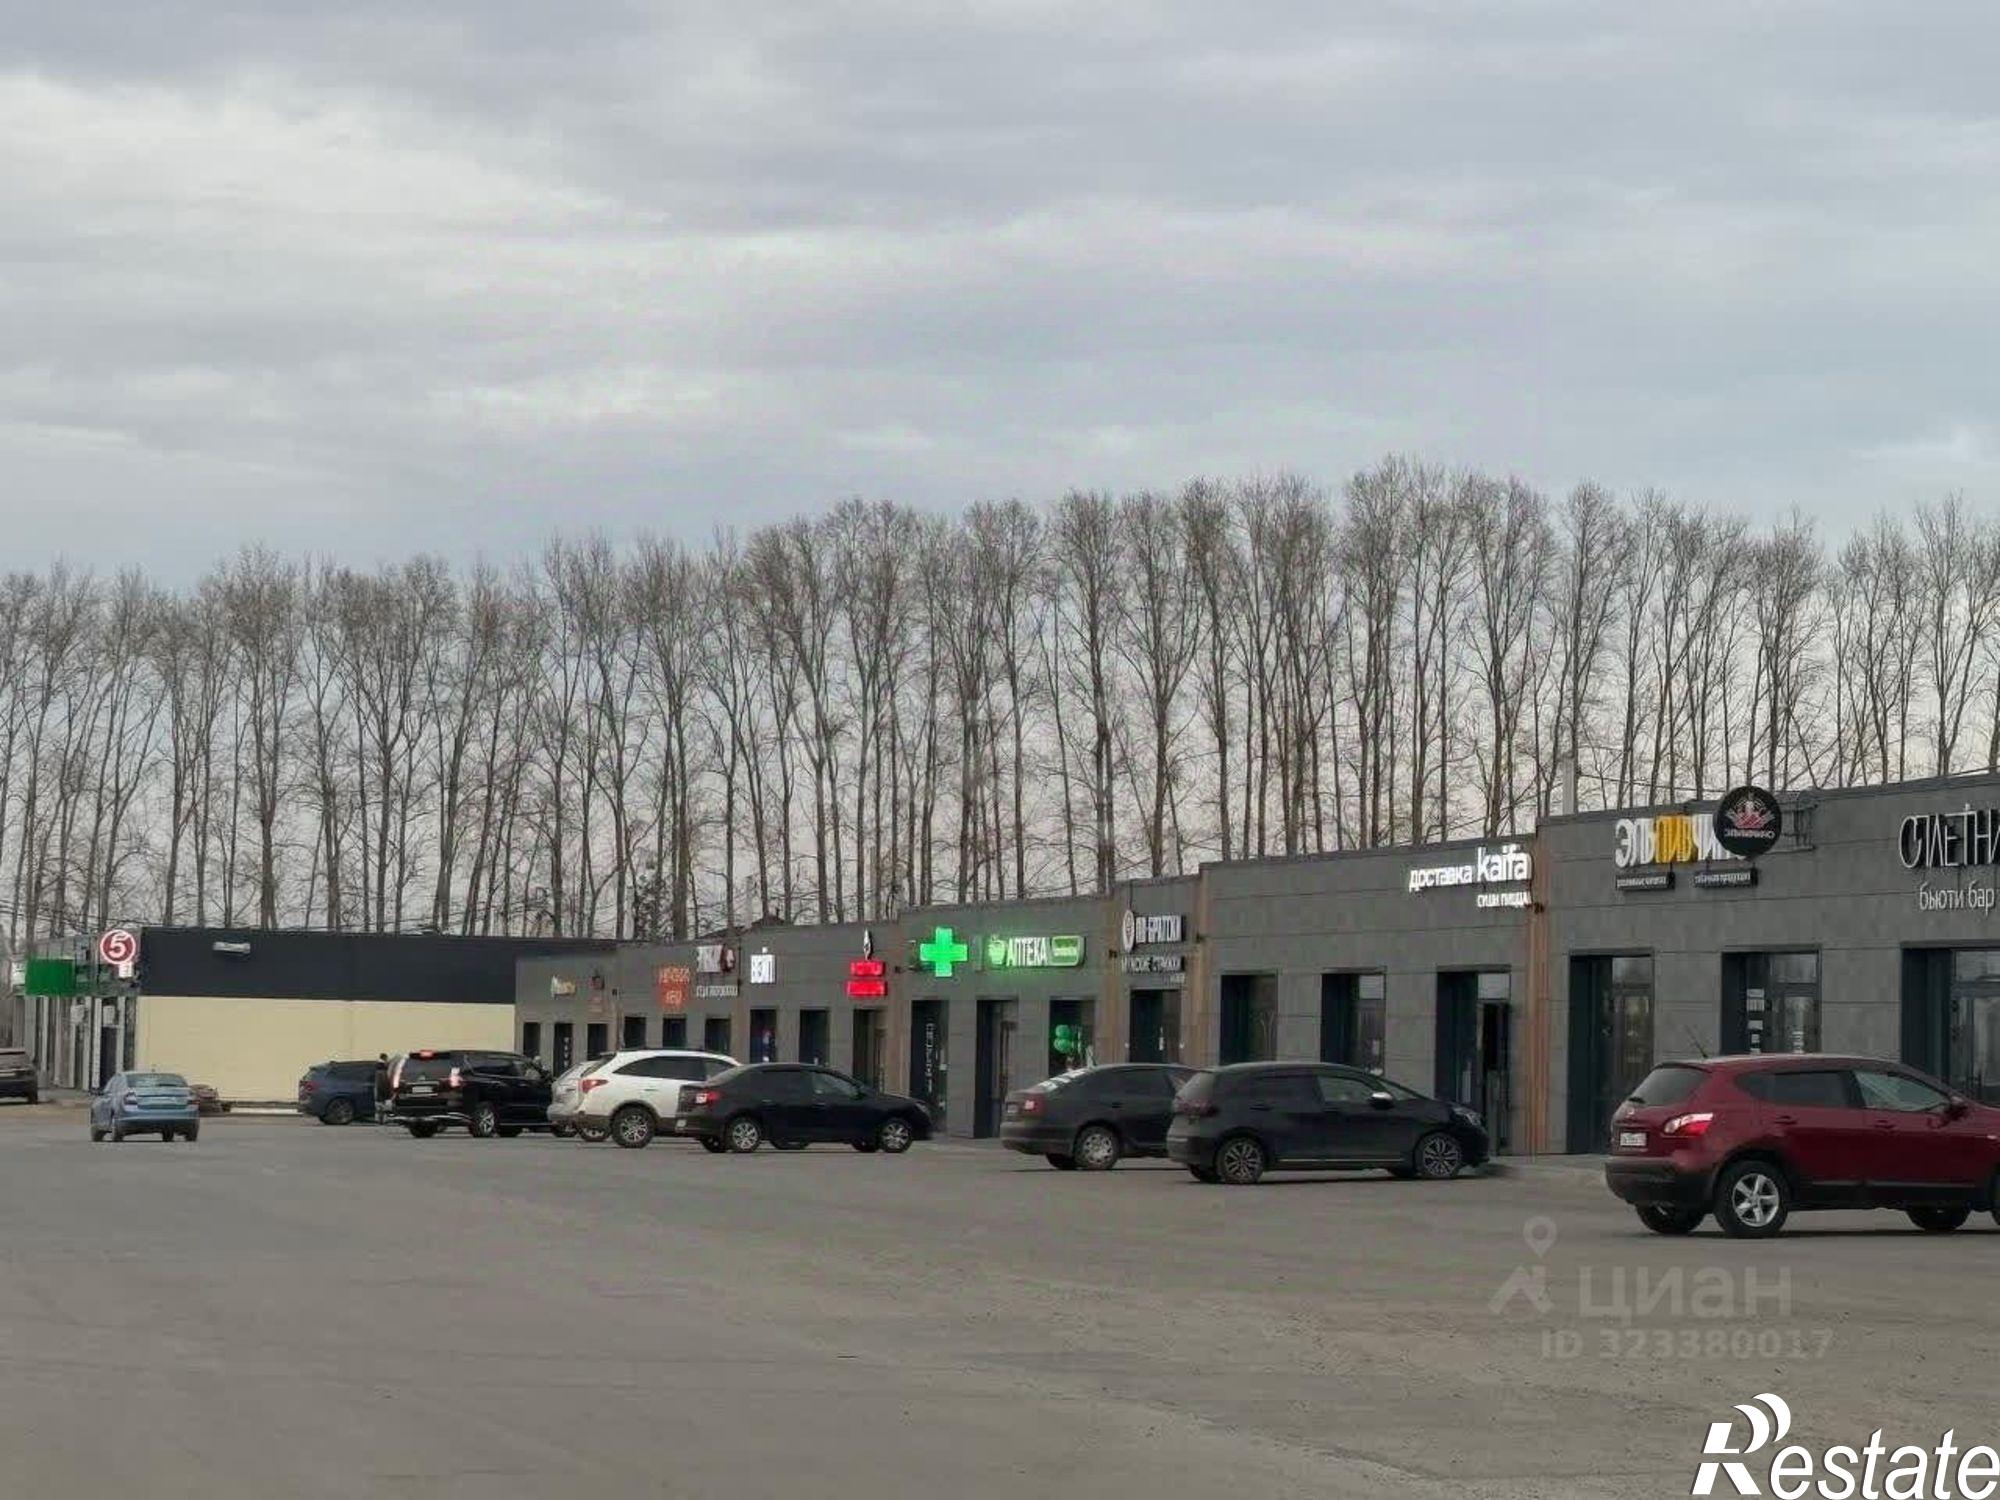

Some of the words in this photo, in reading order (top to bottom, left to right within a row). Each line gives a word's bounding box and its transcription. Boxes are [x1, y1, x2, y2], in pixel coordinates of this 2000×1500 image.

[1409, 865, 1473, 892] доставка
[1477, 844, 1533, 882] kaifa
[1920, 881, 1965, 910] бьюти
[1968, 880, 1995, 917] бар
[1006, 936, 1048, 967] АПТЕКА
